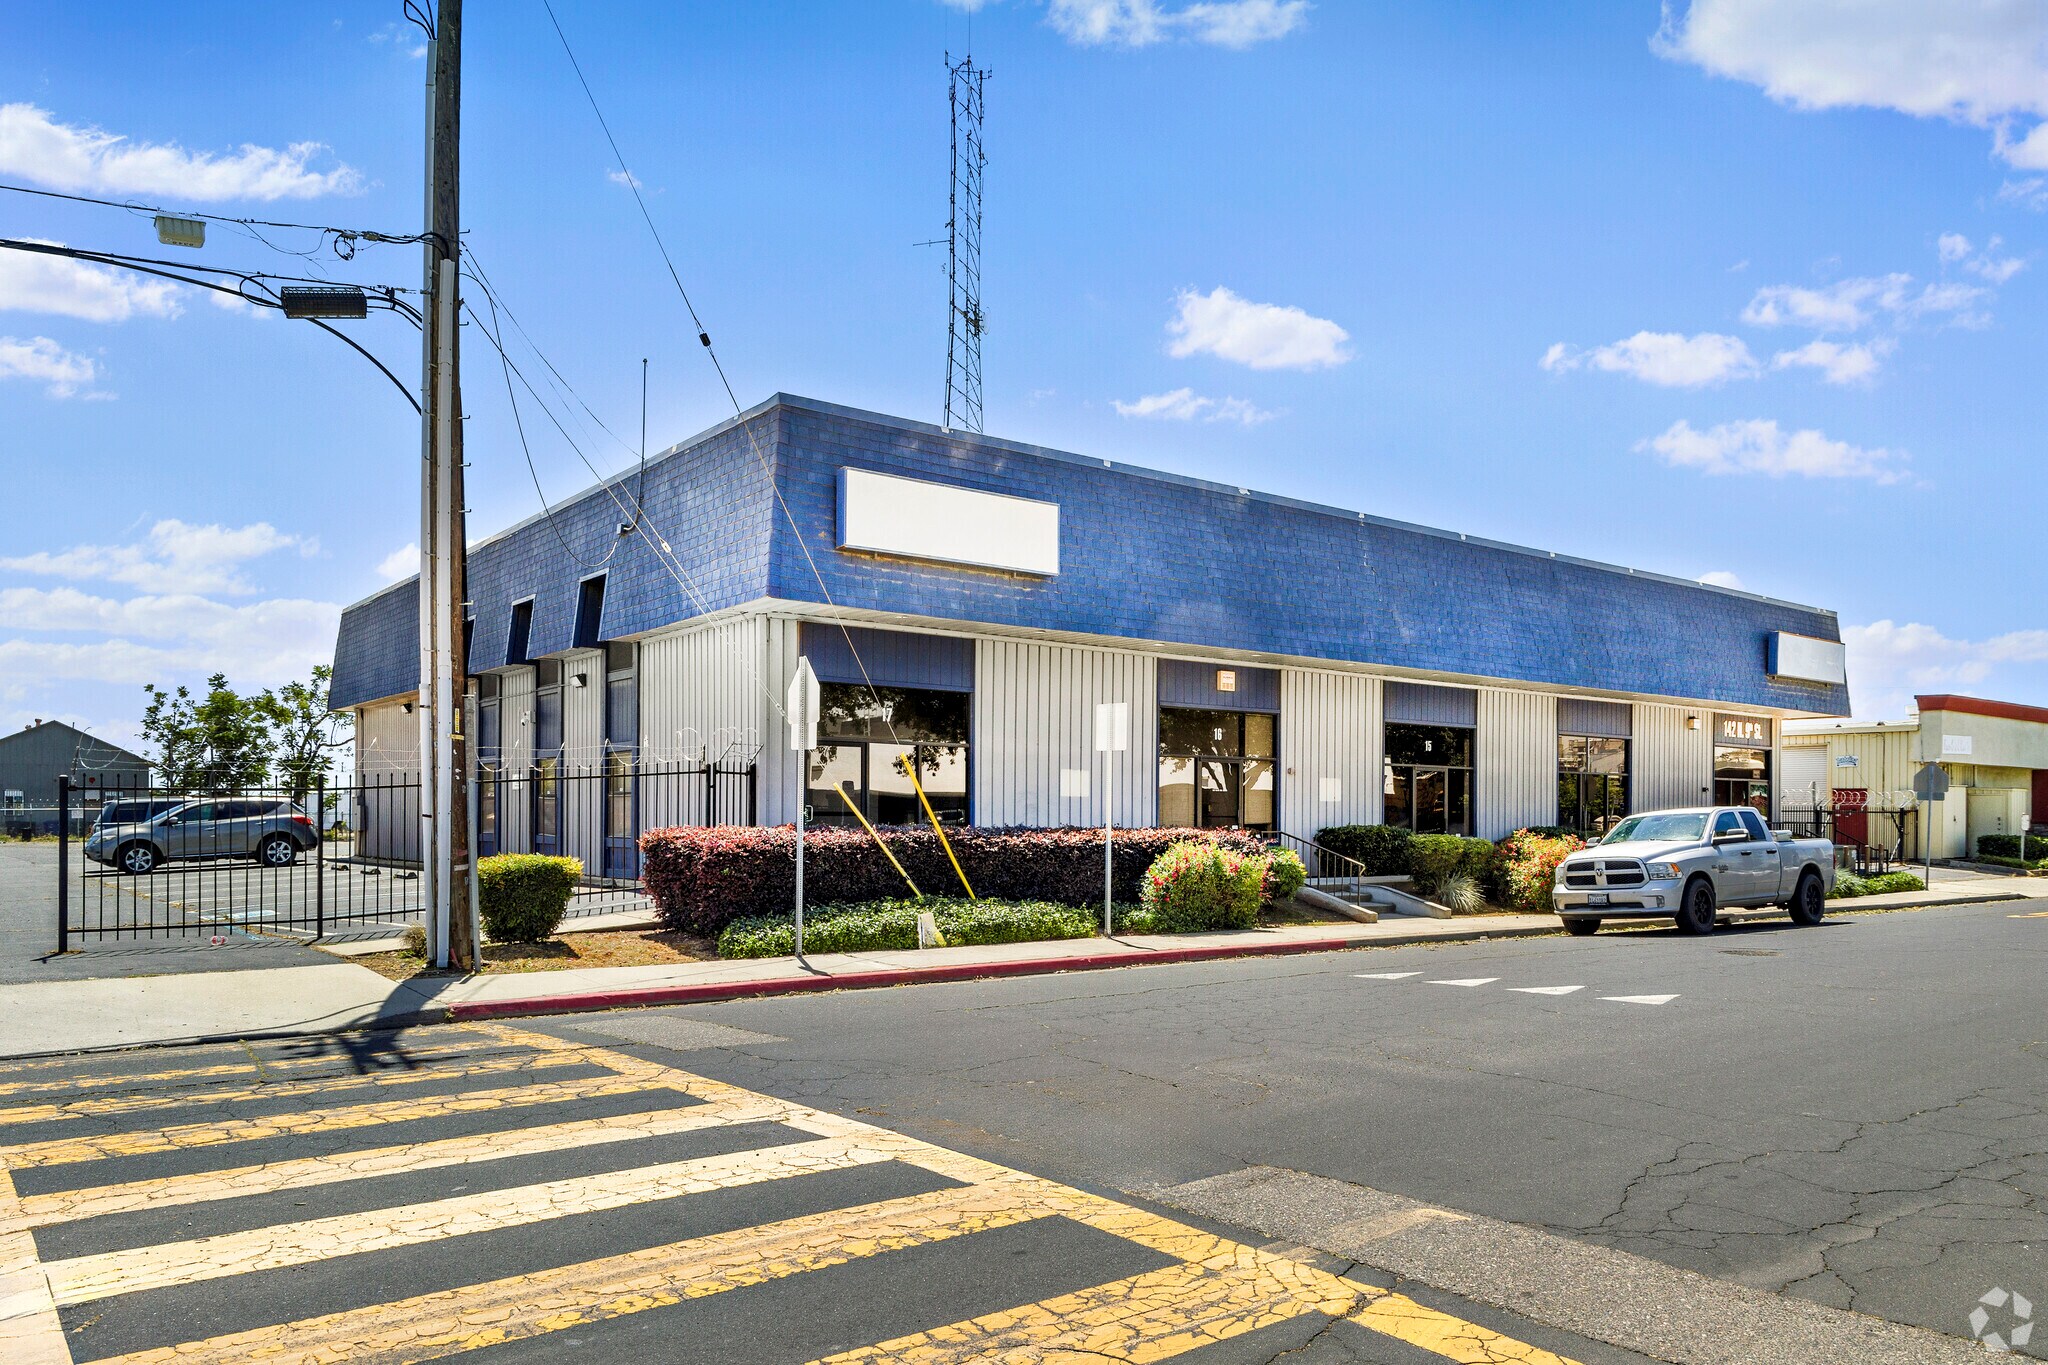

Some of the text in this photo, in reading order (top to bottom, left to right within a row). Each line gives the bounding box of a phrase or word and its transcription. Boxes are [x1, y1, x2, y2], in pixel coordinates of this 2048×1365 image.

[882, 707, 893, 722] 17
[1214, 728, 1222, 740] 16
[1723, 720, 1737, 738] 142
[1424, 740, 1432, 752] 15
